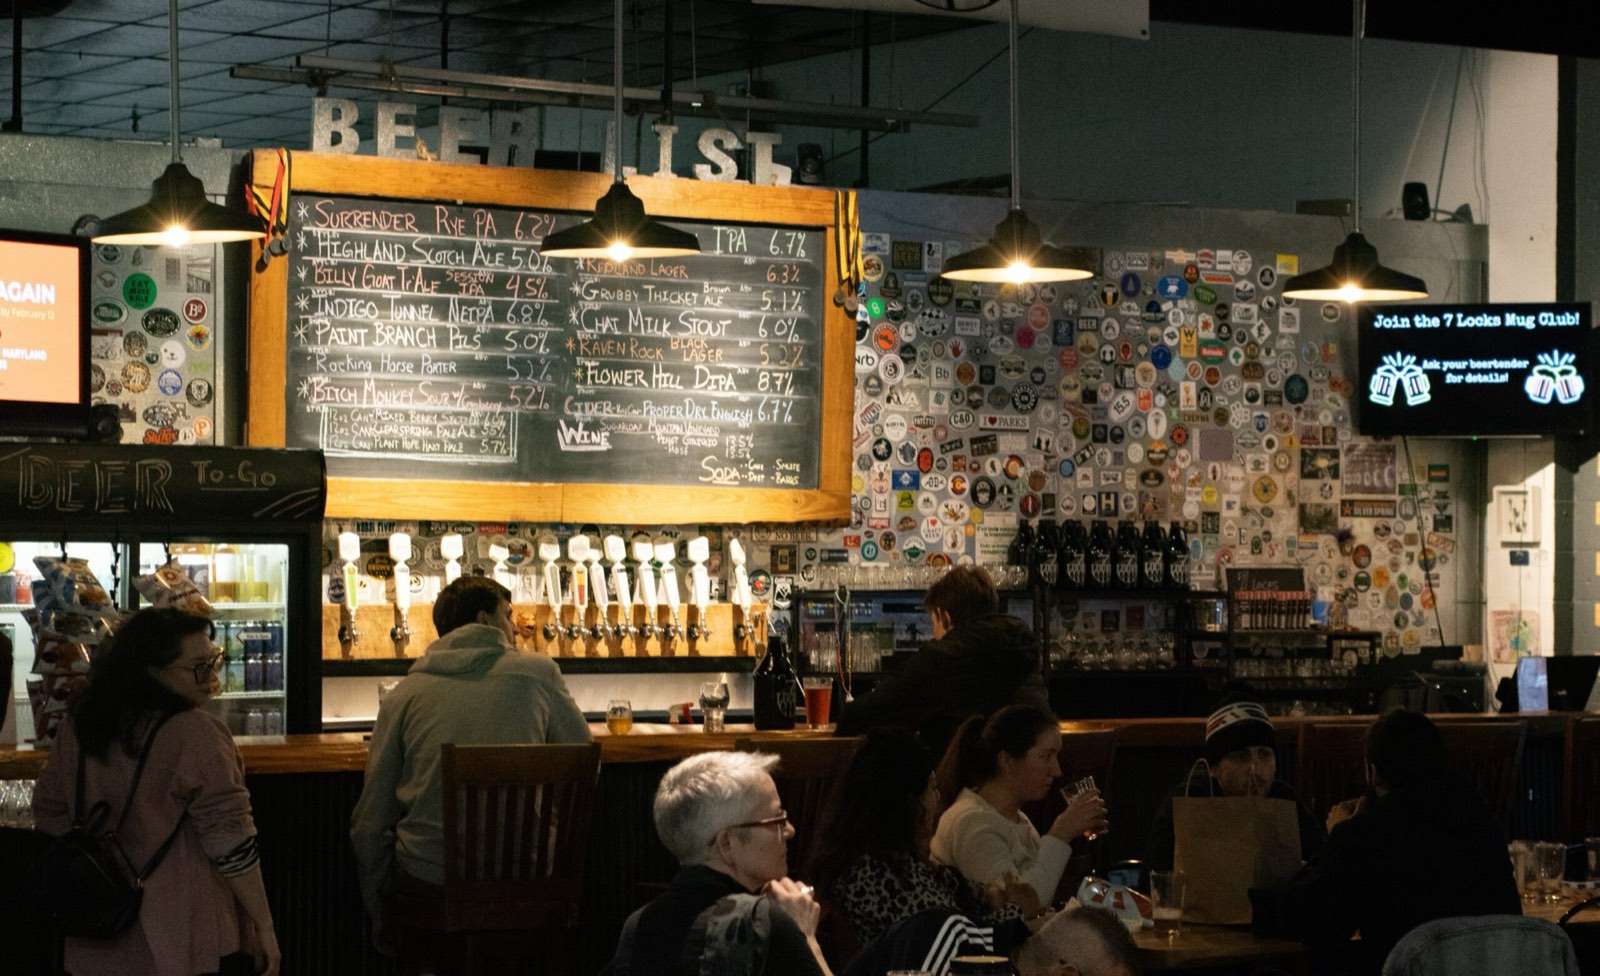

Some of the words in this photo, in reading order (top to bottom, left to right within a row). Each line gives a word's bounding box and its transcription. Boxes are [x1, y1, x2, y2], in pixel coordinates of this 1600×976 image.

[313, 97, 535, 168] BEER
[605, 119, 793, 186] LIST
[315, 200, 418, 233] SURRENDER
[435, 205, 465, 236] RYE
[473, 209, 497, 236] PA
[318, 231, 406, 262] HIGHLAND
[410, 237, 465, 265] SCOTCH
[472, 241, 504, 267] ALE
[713, 226, 747, 254] IPA
[769, 230, 806, 257] 6.7%
[314, 264, 357, 287] BILLY
[362, 265, 395, 290] GOAT
[650, 263, 688, 279] LAGER
[766, 265, 800, 283] 6.3%
[458, 283, 485, 297] IPA
[581, 282, 639, 302] GRUBBY
[643, 285, 699, 306] THICKET
[703, 283, 731, 293] Brown
[313, 295, 378, 318] INDIGO
[382, 294, 440, 323] TUNNEL
[449, 298, 495, 324] NEIPA
[506, 302, 549, 326] 6.8%
[703, 295, 724, 307] ALE
[11, 307, 46, 320] February
[580, 307, 619, 335] CHAI
[629, 307, 671, 337] MILK
[678, 310, 732, 337] STOUT
[1374, 314, 1411, 328] Join
[1414, 314, 1440, 328] the
[1443, 313, 1454, 327] 7
[1456, 313, 1502, 328] Locks
[1505, 312, 1536, 330] Mug
[1538, 312, 1580, 326] Club!
[1079, 319, 1097, 330] BEER
[316, 321, 368, 347] PAINT
[373, 322, 443, 348] BRANCH
[449, 325, 482, 351] PILS
[504, 330, 550, 353] 5.0%
[671, 337, 708, 350] BLACK
[2, 347, 47, 361] MARYLAND
[579, 338, 626, 358] RAVEN
[631, 339, 664, 360] ROCK
[683, 350, 723, 362] LAGER
[1422, 360, 1441, 370] Ask
[1442, 361, 1468, 371] your
[1469, 359, 1530, 370] beertender
[586, 363, 648, 387] FLOWER
[652, 363, 684, 389] HILL
[693, 365, 737, 391] DIPA
[757, 370, 794, 395] 8.7%
[1445, 372, 1464, 383] for
[1465, 373, 1509, 383] details!
[310, 380, 357, 404] BITCH
[418, 382, 450, 407] SOUR
[684, 397, 709, 419] DRY
[711, 401, 753, 421] ENGLISH
[758, 396, 794, 422] 6.7%
[1114, 396, 1130, 415] 15.5
[410, 411, 437, 424] BERRY
[999, 417, 1027, 428] PARKS
[437, 426, 457, 439] PALE
[558, 420, 611, 446] WINE
[726, 432, 753, 449] 13.5%
[443, 440, 463, 453] PALE
[479, 440, 507, 455] 5.7%
[699, 455, 740, 481] SODA
[20, 455, 174, 513] BEER
